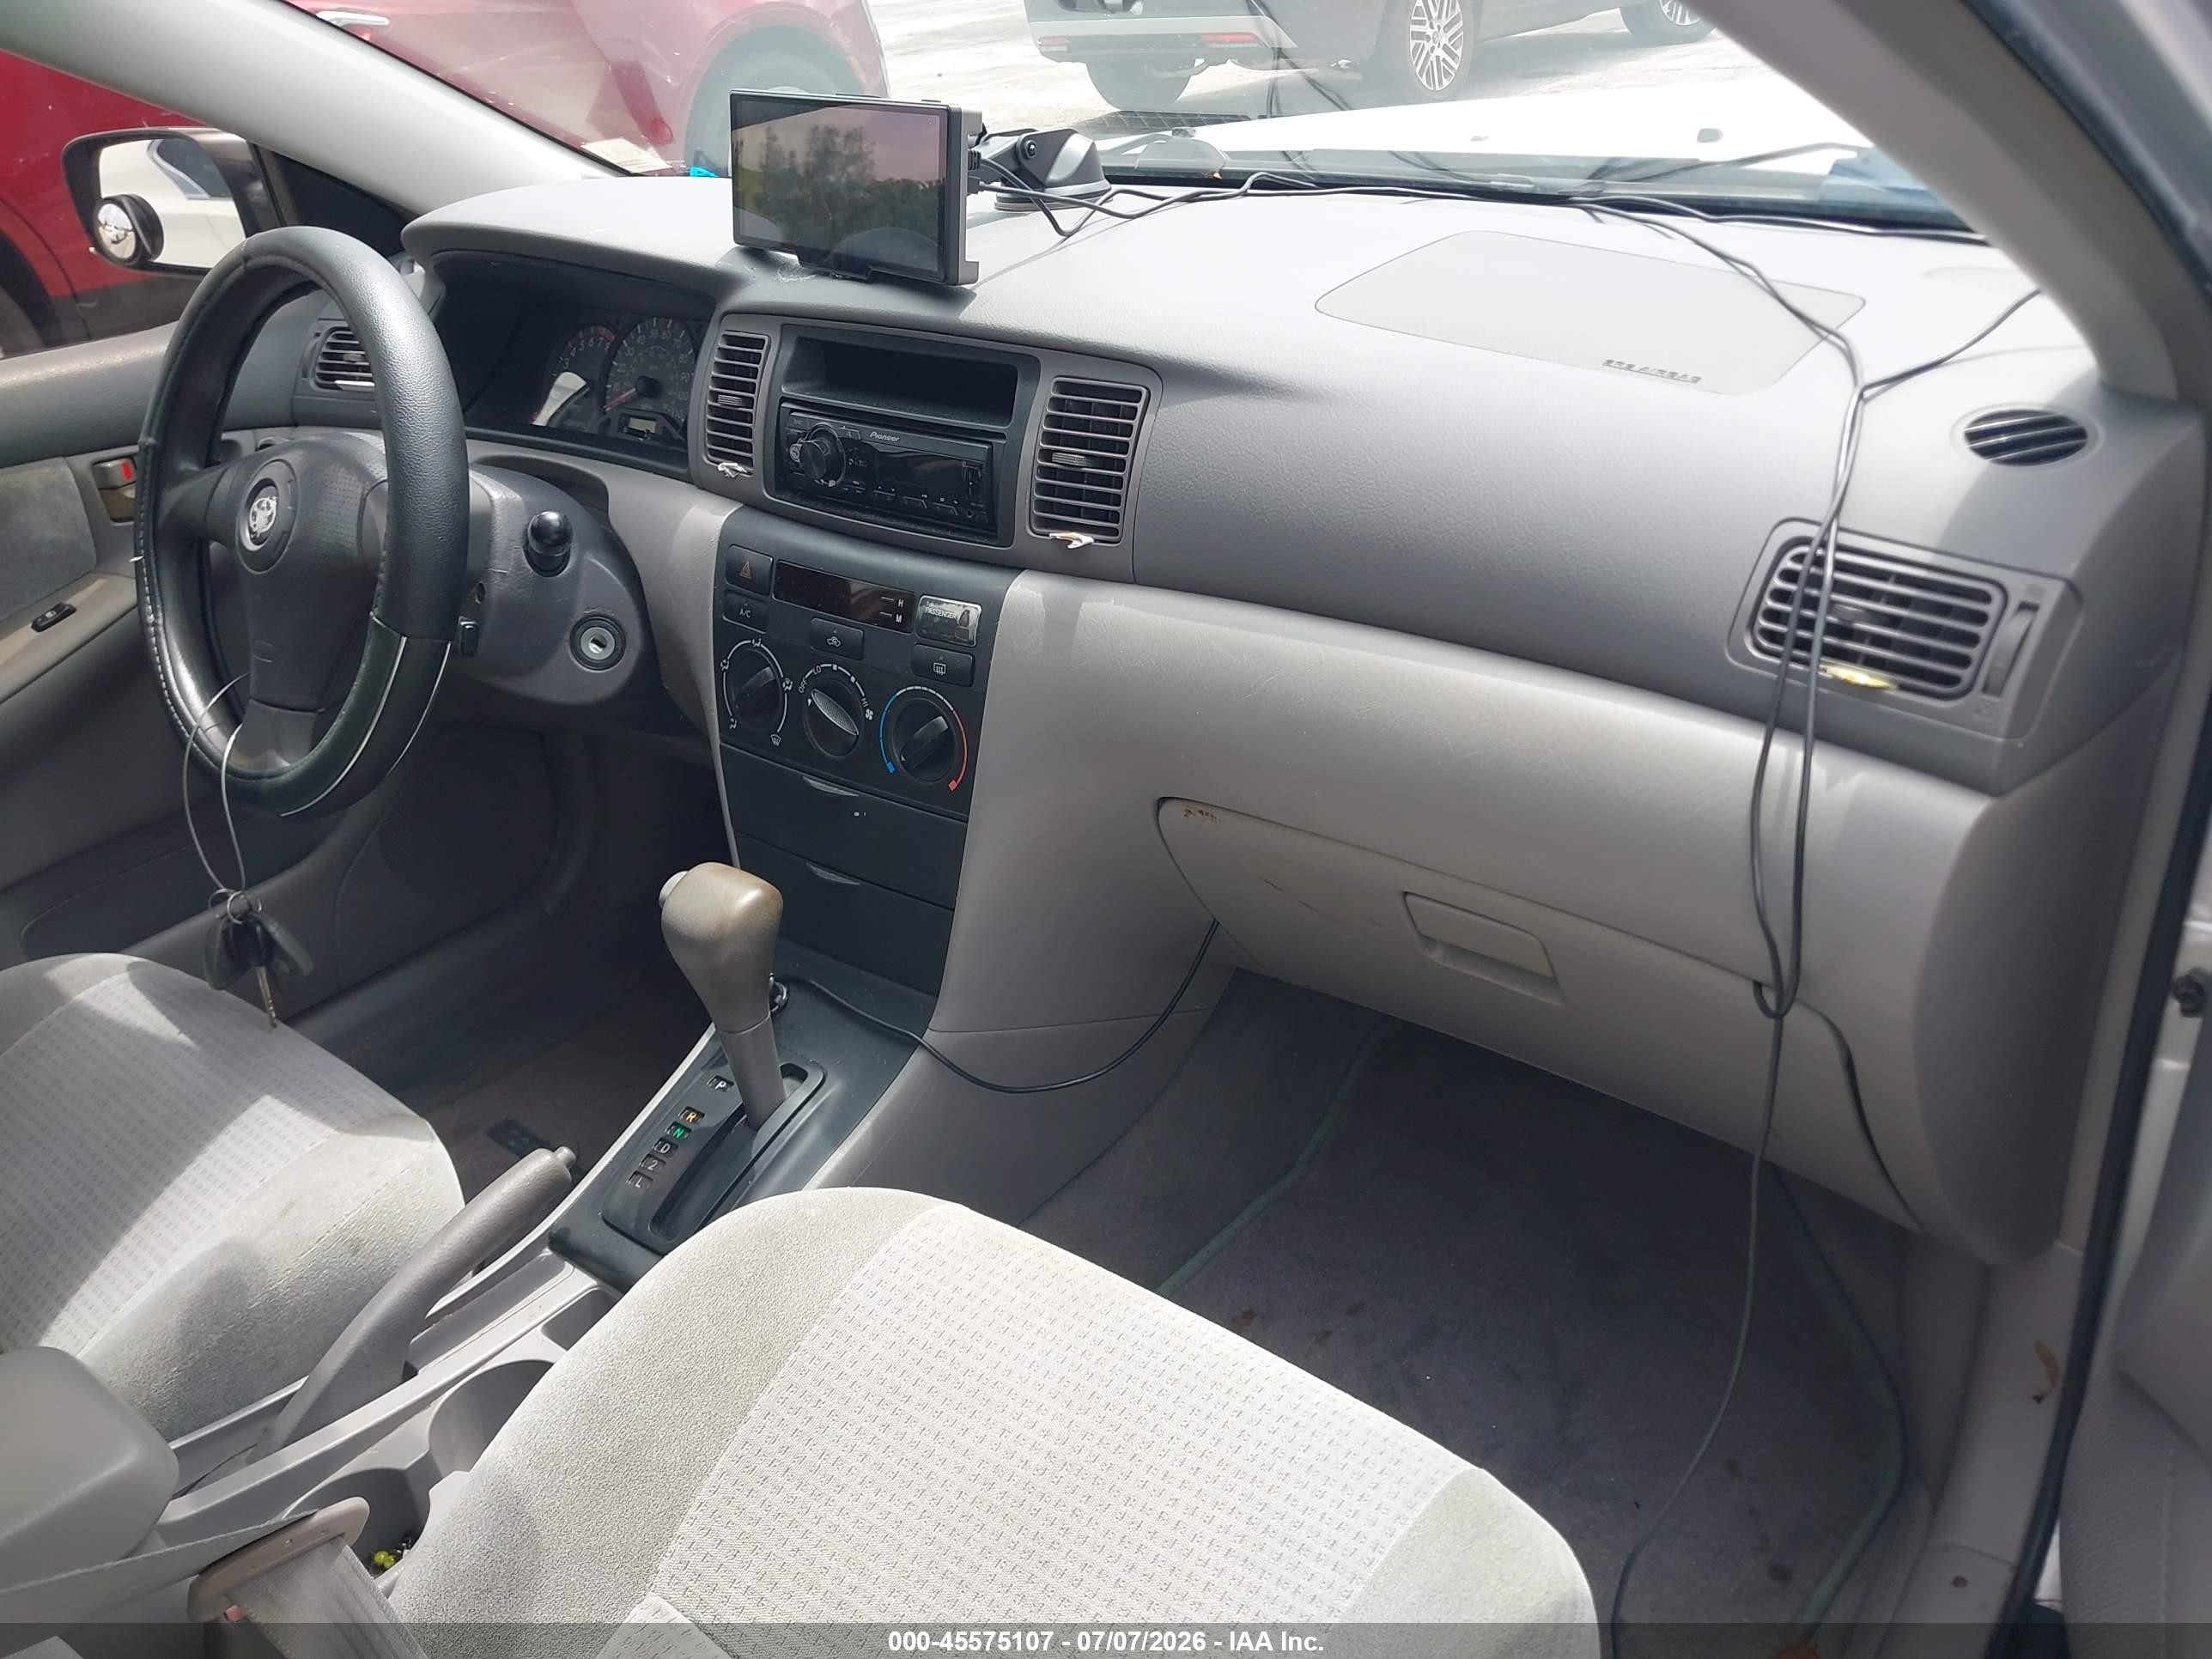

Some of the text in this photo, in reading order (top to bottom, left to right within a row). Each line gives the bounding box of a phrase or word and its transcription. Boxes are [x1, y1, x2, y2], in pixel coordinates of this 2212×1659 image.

[869, 431, 900, 442] Pioneer
[897, 599, 904, 608] H
[896, 613, 902, 623] M
[925, 607, 957, 619] PASSENGER
[714, 1080, 727, 1090] P
[686, 1112, 696, 1122] R
[672, 1127, 684, 1139] N
[661, 1143, 671, 1154] D
[647, 1160, 658, 1170] 2
[635, 1177, 642, 1188] L
